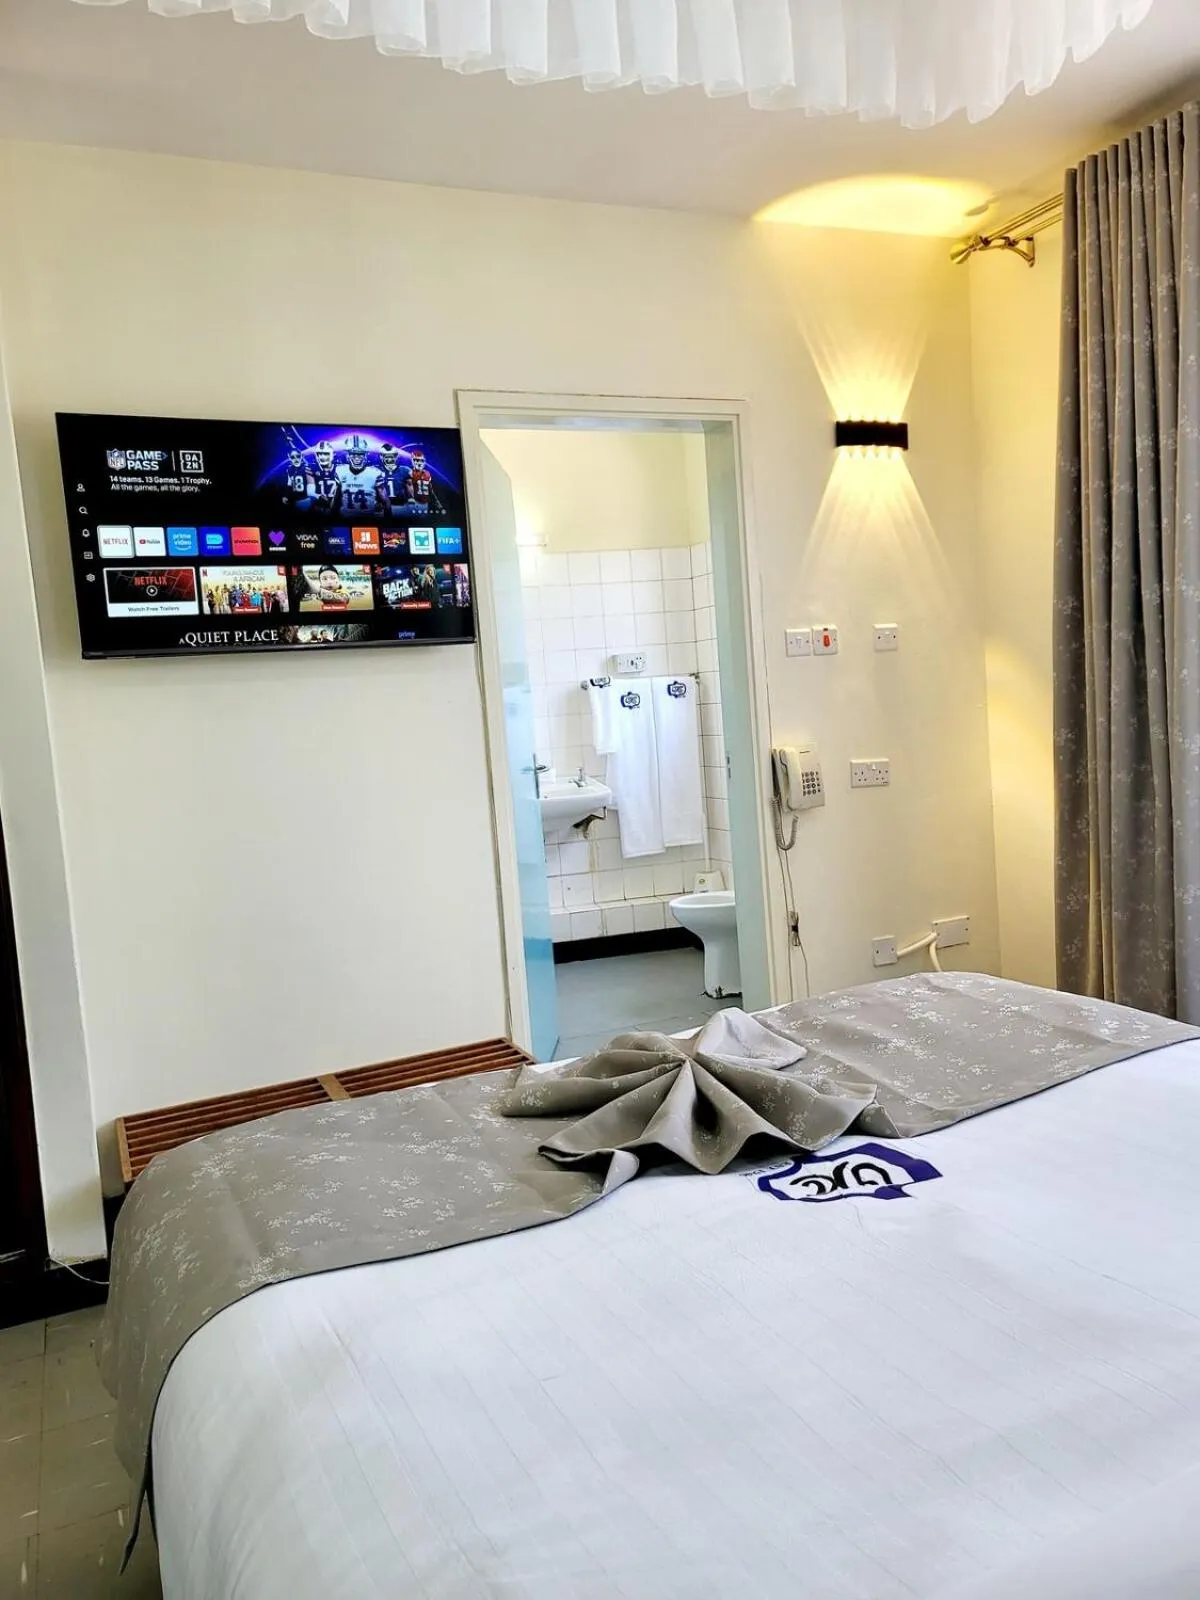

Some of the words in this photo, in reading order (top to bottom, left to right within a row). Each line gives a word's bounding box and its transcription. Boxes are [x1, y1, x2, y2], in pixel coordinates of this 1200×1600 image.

[126, 450, 163, 461] GAME
[127, 460, 159, 471] PASS
[110, 475, 118, 483] 14
[154, 476, 180, 484] Games.
[185, 477, 212, 486] Trophy.
[111, 483, 120, 491] All
[134, 485, 159, 493] games,
[169, 484, 180, 492] the
[182, 485, 200, 493] glory.
[318, 479, 338, 498] 17
[387, 479, 397, 498] 1
[103, 538, 129, 546] NETFLIX
[300, 541, 316, 549] free
[354, 541, 379, 550] News
[134, 575, 167, 586] NETFLIX
[382, 578, 411, 595] BACK
[387, 587, 414, 601] ACTION
[128, 605, 145, 613] Watch
[160, 604, 180, 612] Trailers
[185, 631, 230, 646] QUIET
[235, 629, 279, 643] PLACE
[398, 631, 416, 639] prime
